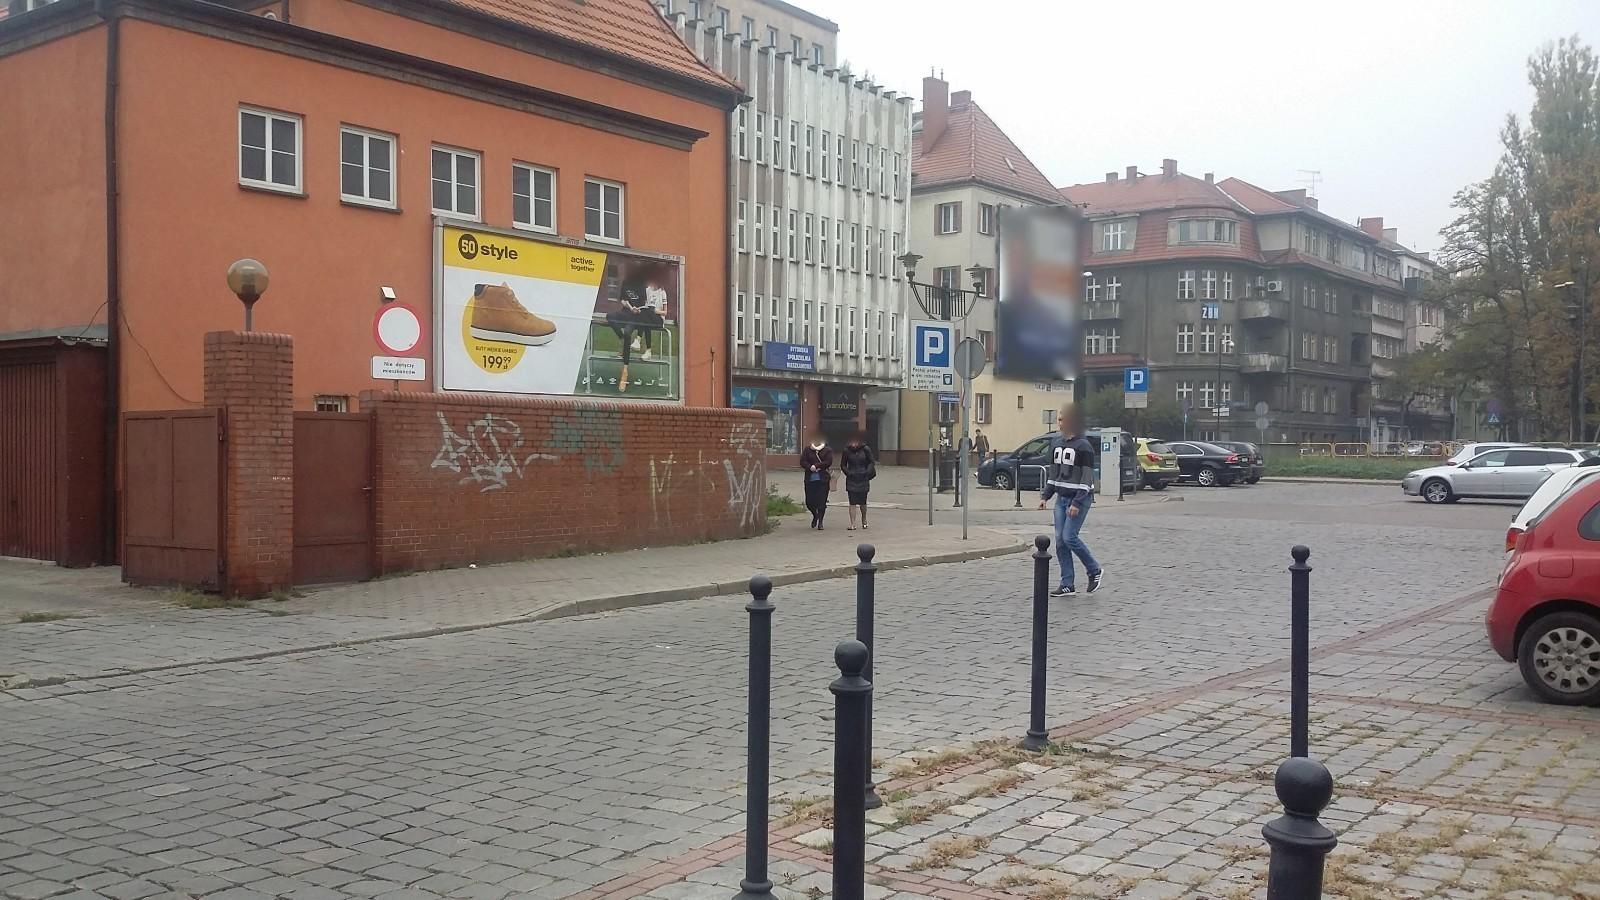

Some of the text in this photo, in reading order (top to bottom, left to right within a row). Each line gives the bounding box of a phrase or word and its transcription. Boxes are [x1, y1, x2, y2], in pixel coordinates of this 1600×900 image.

[461, 239, 518, 261] 50 style
[570, 256, 595, 266] active.
[570, 264, 595, 273] together
[923, 330, 944, 363] P
[395, 361, 415, 369] dotyczy
[482, 354, 503, 369] 199
[1130, 370, 1144, 390] P
[1103, 443, 1110, 451] P
